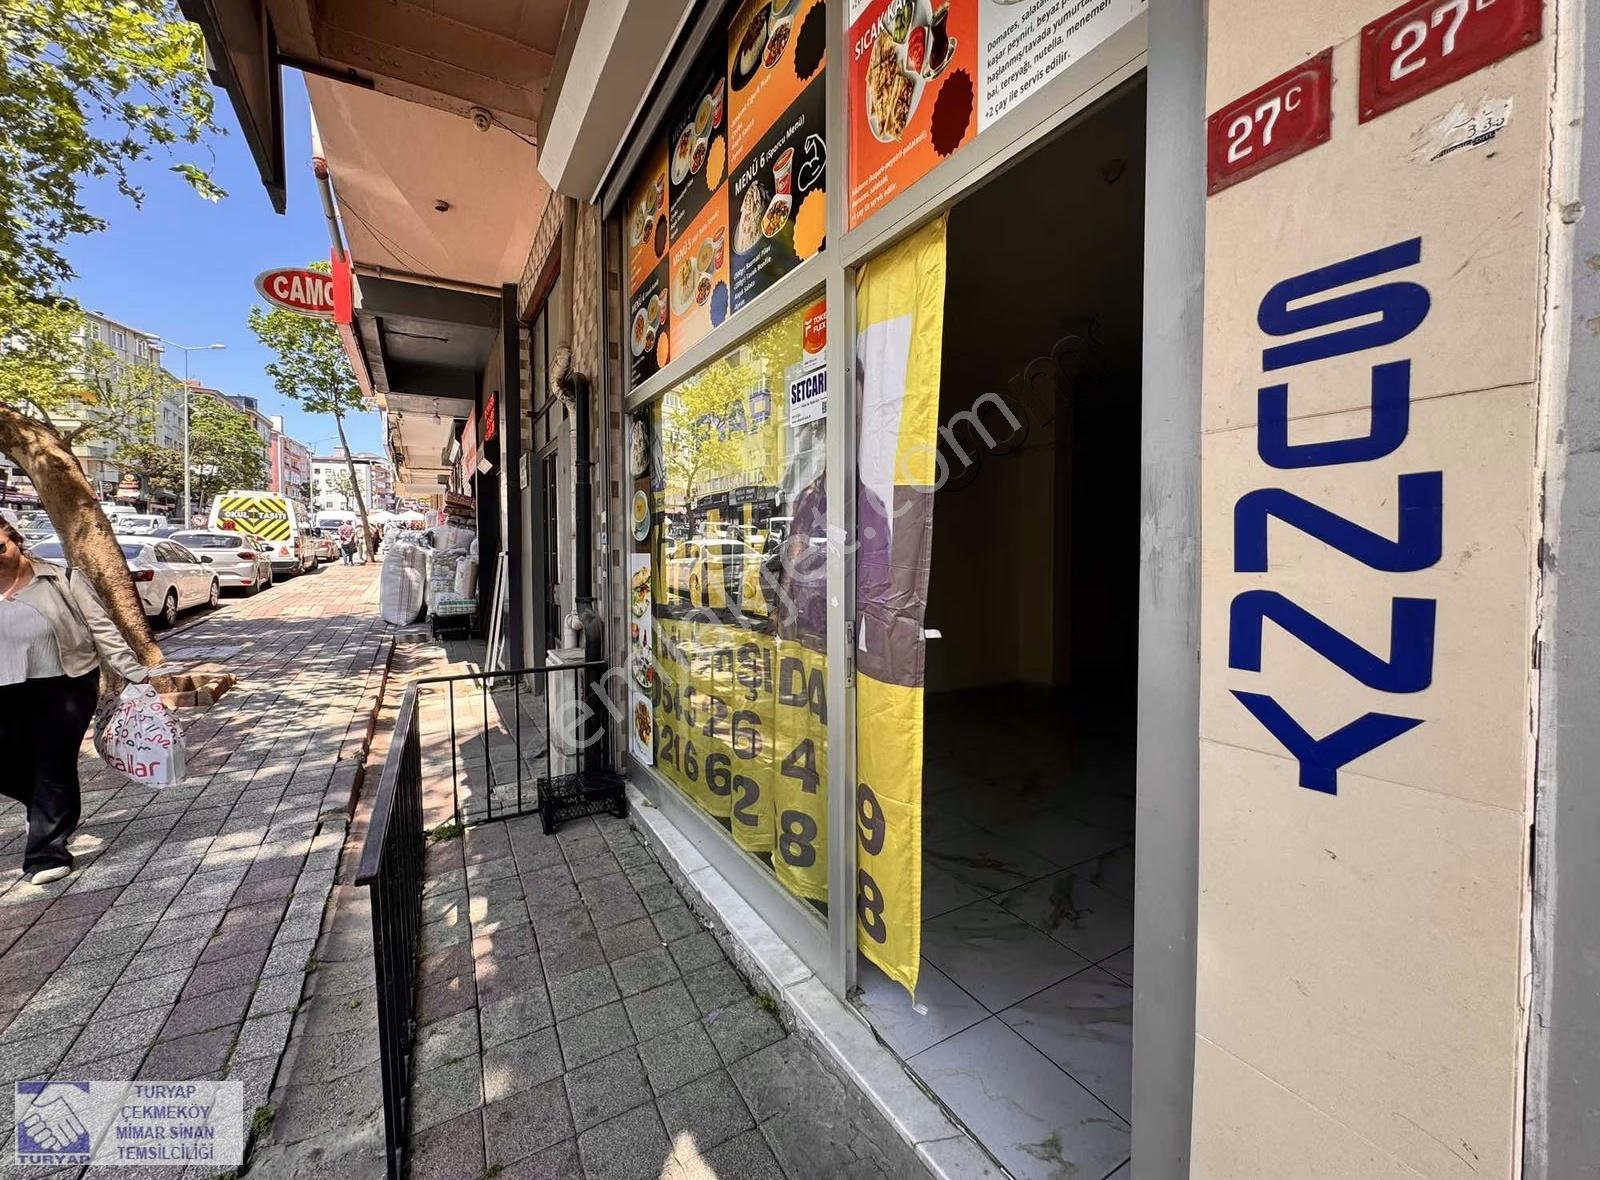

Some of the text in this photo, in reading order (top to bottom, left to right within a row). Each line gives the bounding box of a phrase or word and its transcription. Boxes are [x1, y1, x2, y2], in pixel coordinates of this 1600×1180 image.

[855, 12, 885, 61] SICAK
[987, 46, 1006, 69] kaşar
[1007, 21, 1035, 55] peyniri,
[1037, 3, 1061, 28] beyaz
[987, 21, 1020, 54] Domates,
[985, 50, 1071, 120] +2 çay ile servis edilir.
[735, 156, 759, 196] MENÜ
[759, 151, 766, 169] 6
[224, 510, 250, 518] OKUL
